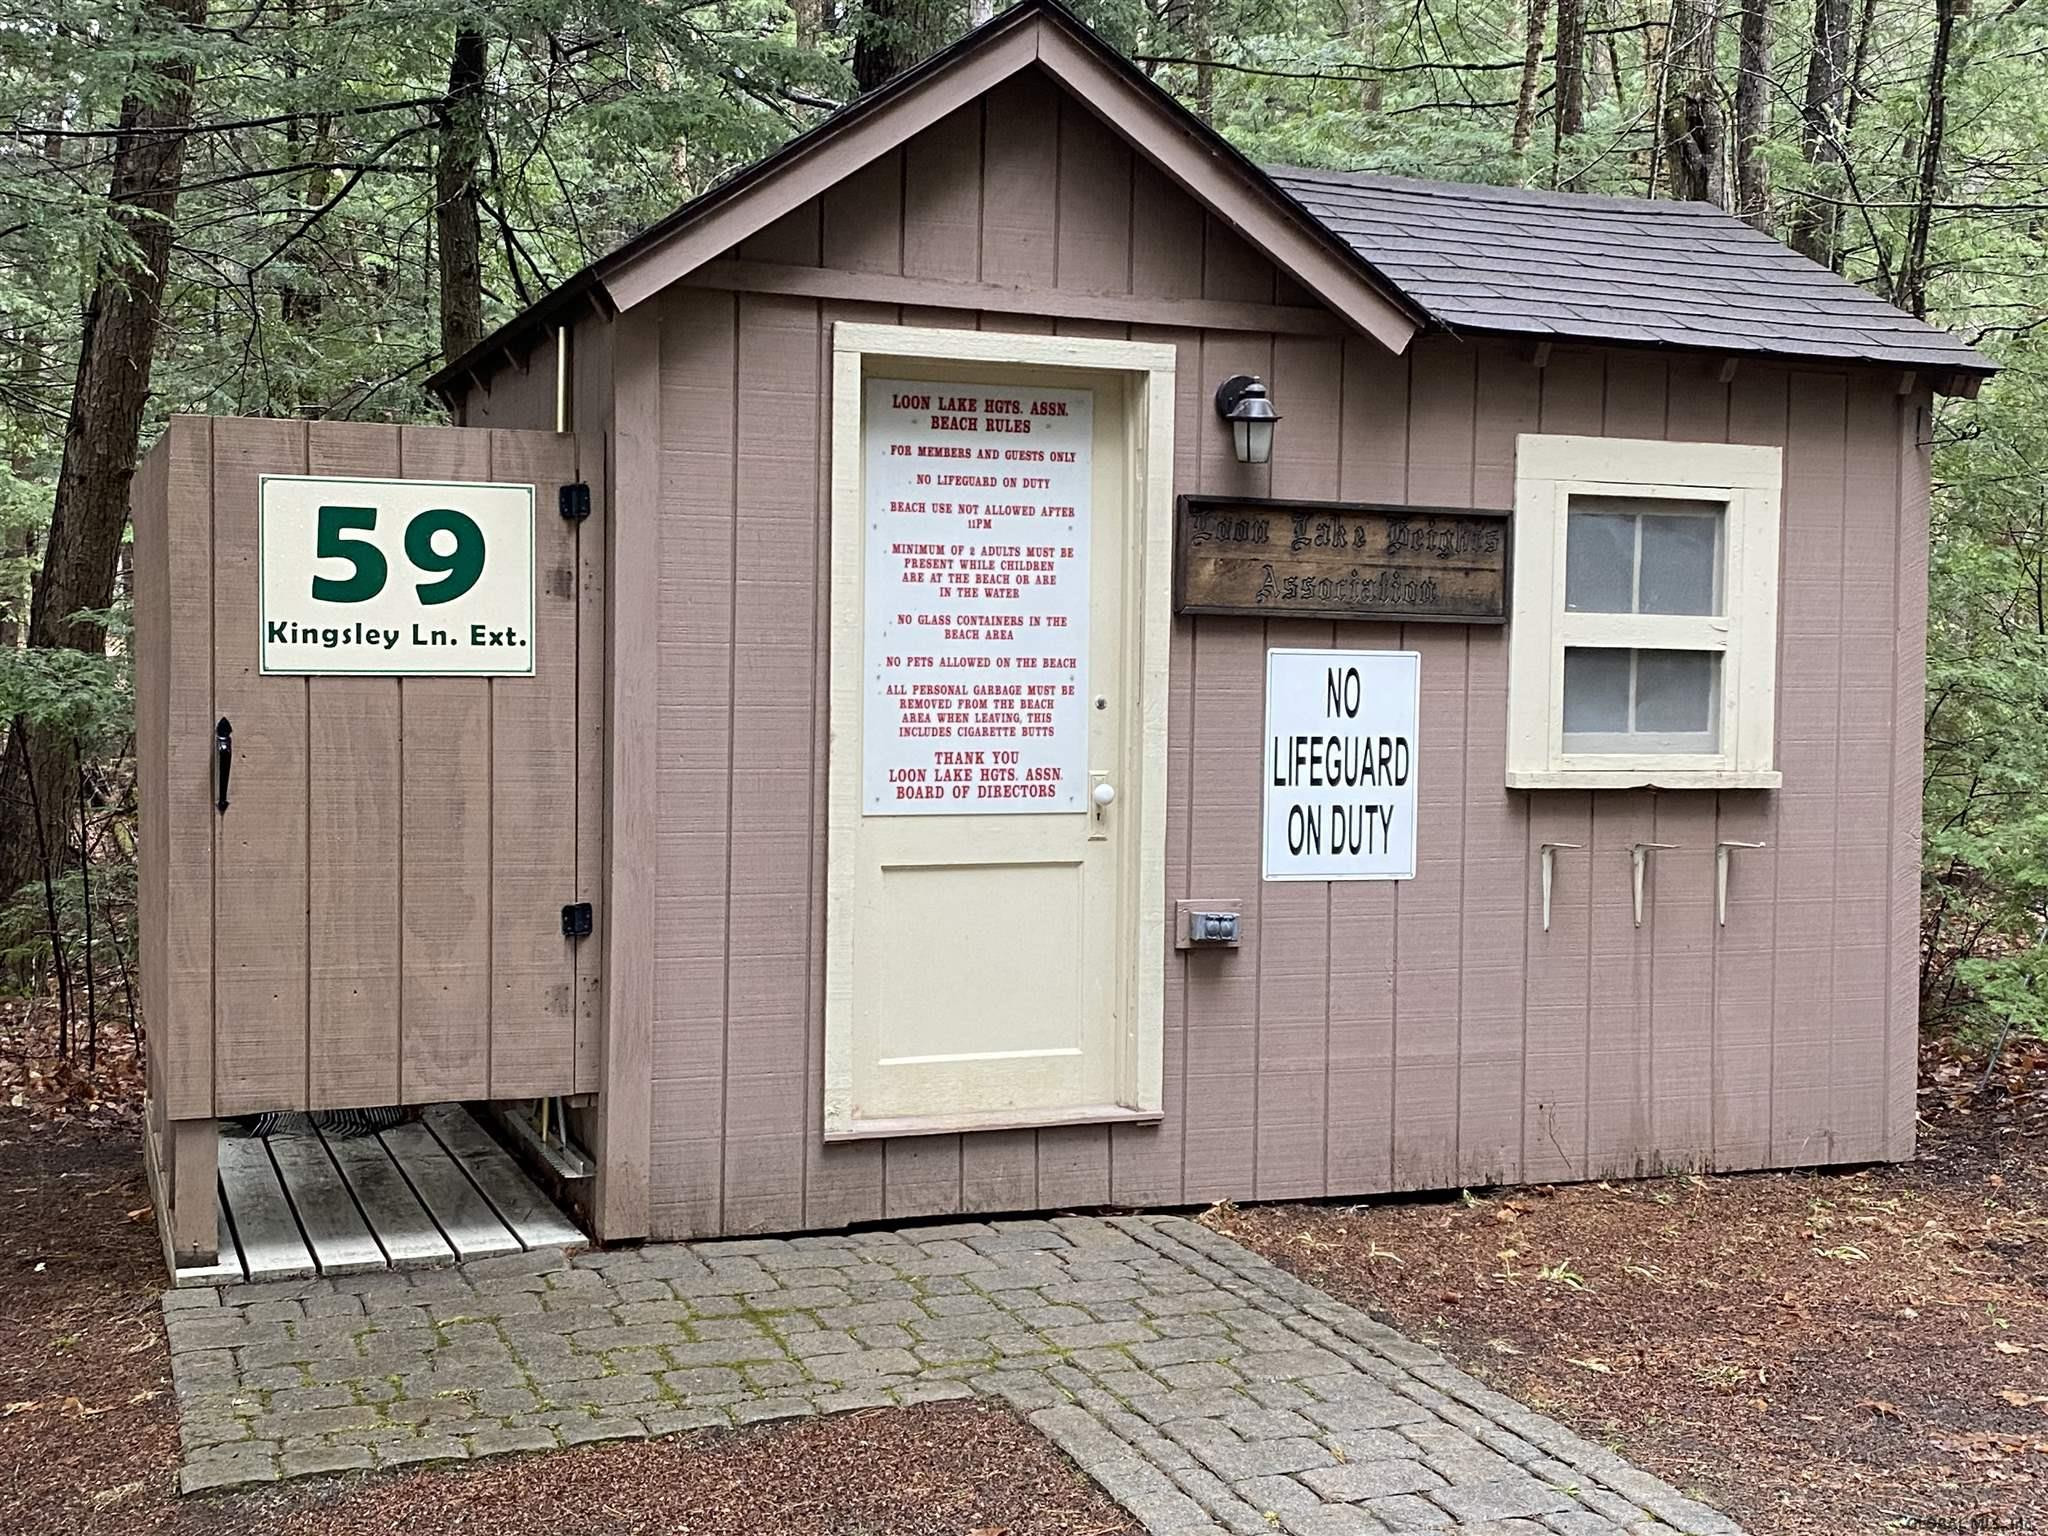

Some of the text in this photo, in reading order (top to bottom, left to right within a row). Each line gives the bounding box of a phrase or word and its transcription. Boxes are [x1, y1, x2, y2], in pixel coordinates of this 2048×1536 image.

[893, 395, 1068, 416] LOON LAKE HGTS. ASSN.
[931, 416, 1031, 433] BEACH RULES
[891, 445, 1076, 462] FOR MEMBERS AND GUESTS ONLY
[917, 475, 1050, 489] NO LIFEGUARD ON DUTY
[891, 502, 1075, 517] BEACH USE NOT ALLOWED AFTER
[968, 519, 992, 529] 11PM
[1191, 510, 1500, 558] Loon Lake Heights
[312, 506, 486, 605] 59
[892, 544, 1074, 557] MINIMUM OF 2 ADULTS MUST BE
[904, 559, 1054, 571] PRESENT WHILE CHILDREN
[902, 573, 1056, 585] ARE AT THE BEACH OR ARE
[1256, 564, 1438, 604] Association
[940, 588, 1020, 598] IN THE WATER
[897, 615, 1067, 627] NO GLASS CONTAINERS IN THE
[268, 621, 526, 649] Kingsley Ln. Ext.
[945, 629, 1014, 640] BEACH AREA
[886, 657, 1076, 668] NO PETS ALLOWED ON THE BEACH
[886, 685, 1075, 696] ALL PERSONAL GARBAGE MUST BE
[1327, 667, 1360, 718] NO
[900, 699, 1054, 709] REMOVED FROM THE BEACH
[902, 713, 1052, 724] AREA WHEN LEAVING, THIS
[899, 727, 1054, 737] INCLUDES CIGARETTE BUTTS
[935, 751, 1019, 764] THANK YOU
[1274, 736, 1409, 787] LIFEGUARD
[889, 768, 1063, 782] LOON LAKE HGTS. ASSN.
[896, 784, 1055, 799] BOARD OF DIRECTORS
[1288, 804, 1394, 855] ON DUTY
